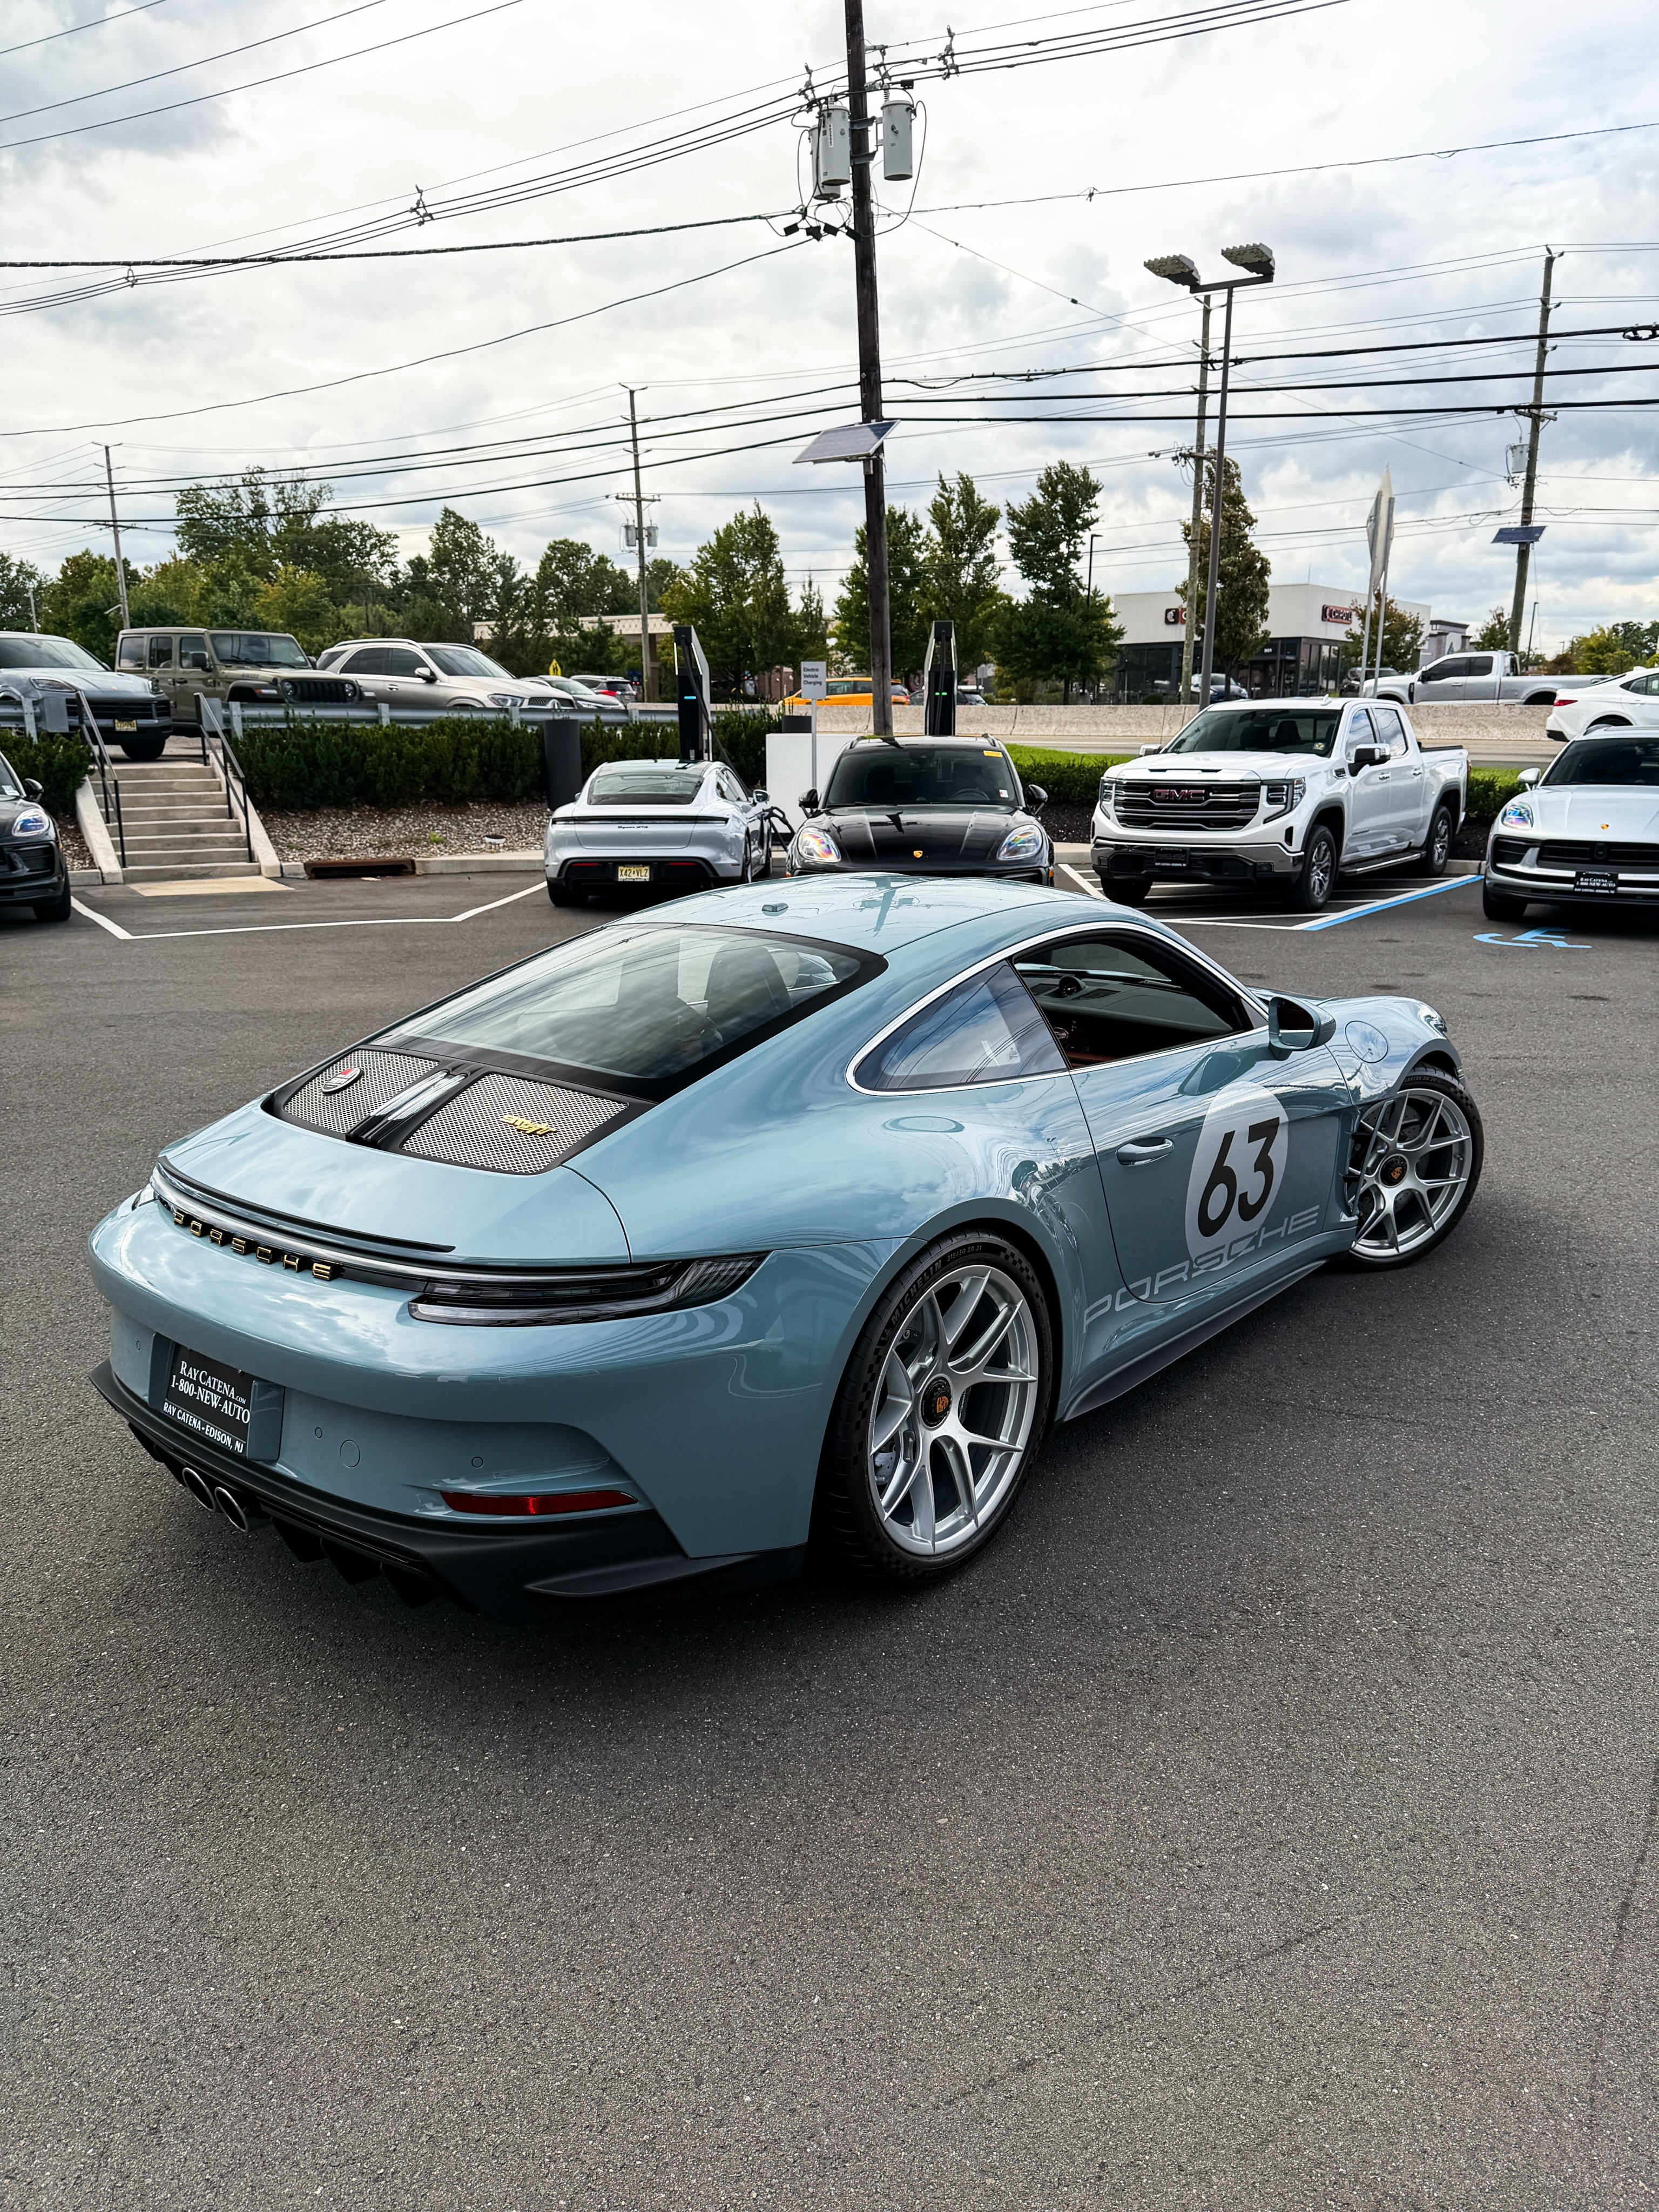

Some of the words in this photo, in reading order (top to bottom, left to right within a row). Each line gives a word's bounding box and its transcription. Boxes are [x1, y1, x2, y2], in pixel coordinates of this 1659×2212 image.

[1154, 789, 1205, 800] GMC
[1197, 1117, 1280, 1237] 63
[174, 1211, 331, 1280] PORSCHE
[1083, 1205, 1319, 1333] PORSCHE
[891, 1259, 942, 1326] MICHELIN
[947, 1249, 966, 1261] 315/30
[163, 1402, 177, 1416] RAY
[234, 1440, 244, 1453] NJ
[171, 1375, 250, 1424] 1-800-NEW-AUTO
